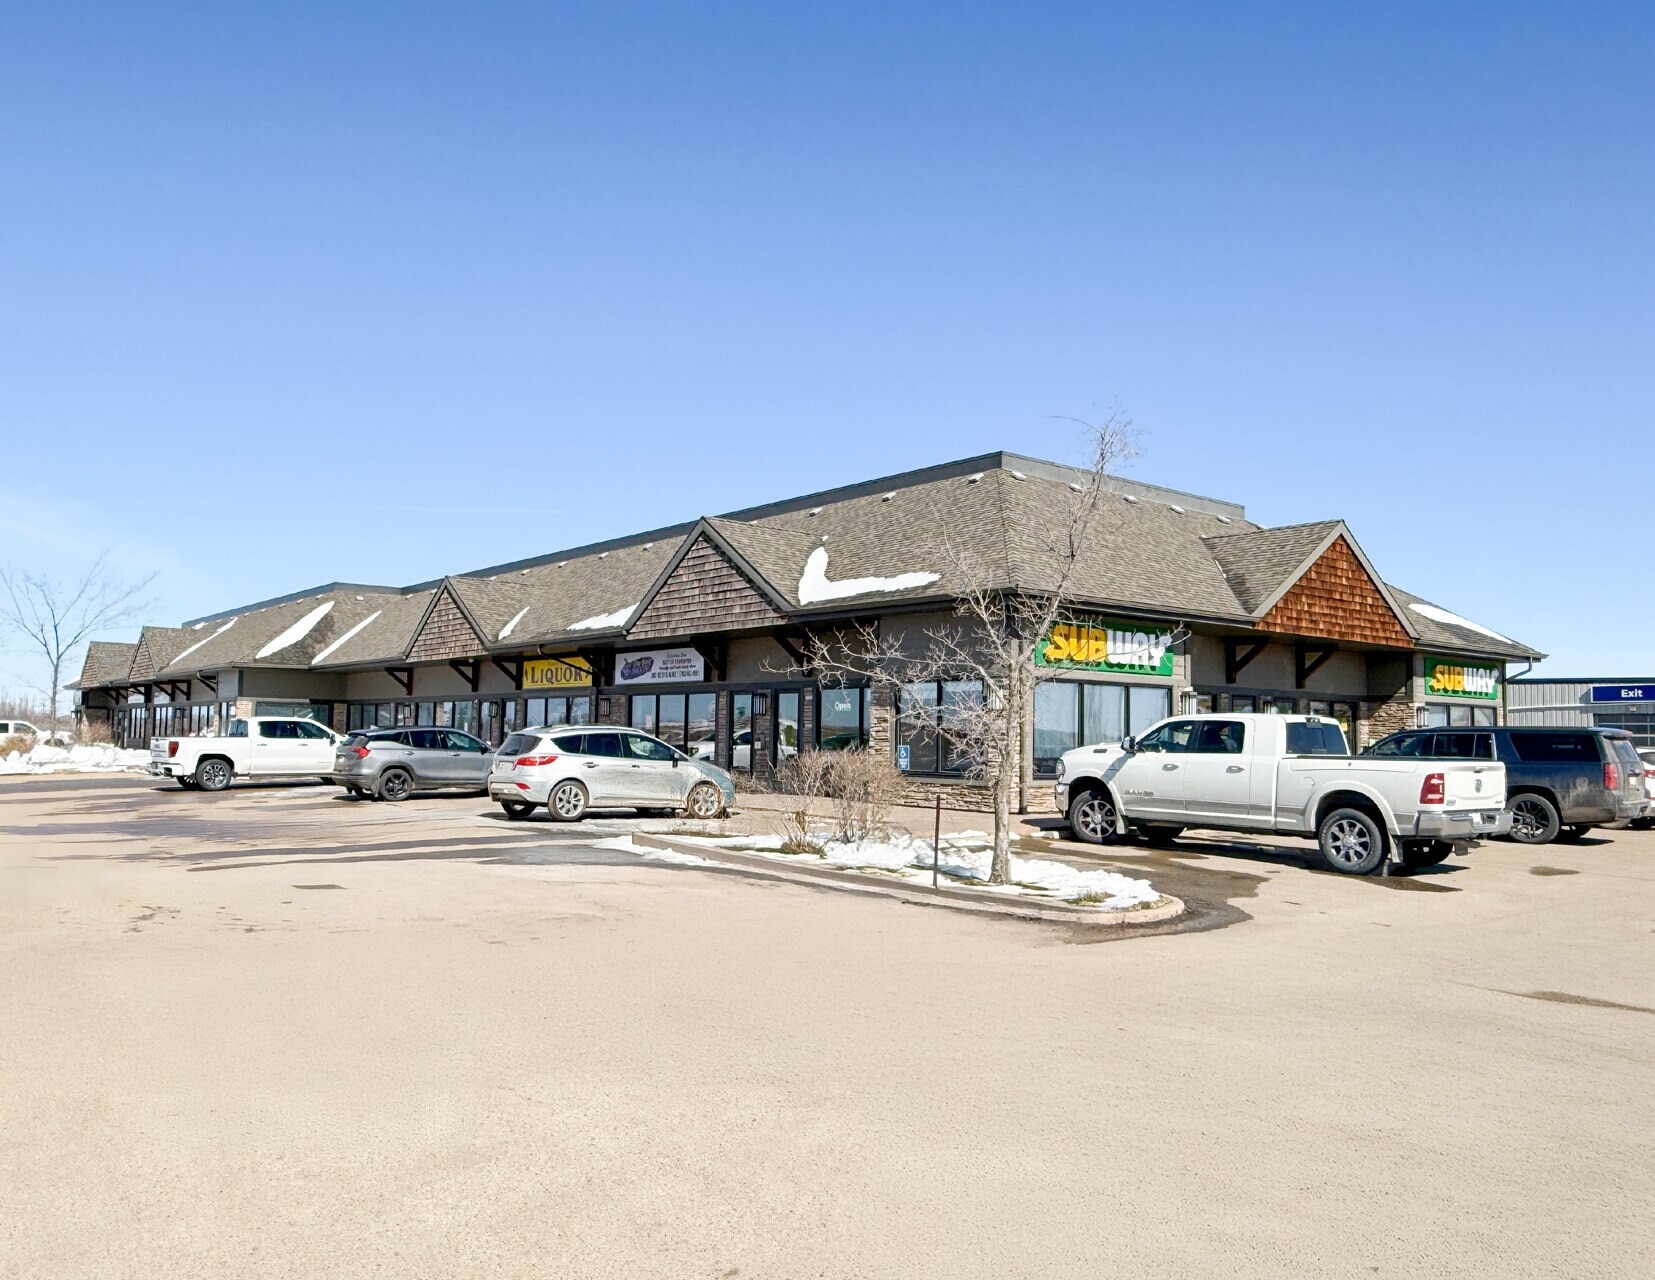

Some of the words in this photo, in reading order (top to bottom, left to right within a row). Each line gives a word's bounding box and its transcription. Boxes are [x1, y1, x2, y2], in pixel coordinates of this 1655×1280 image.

[1043, 624, 1172, 667] SUBWAY
[531, 666, 583, 685] LIQUOR
[1430, 664, 1499, 694] SUBWAY
[1621, 689, 1643, 698] Exit
[834, 701, 852, 711] Open
